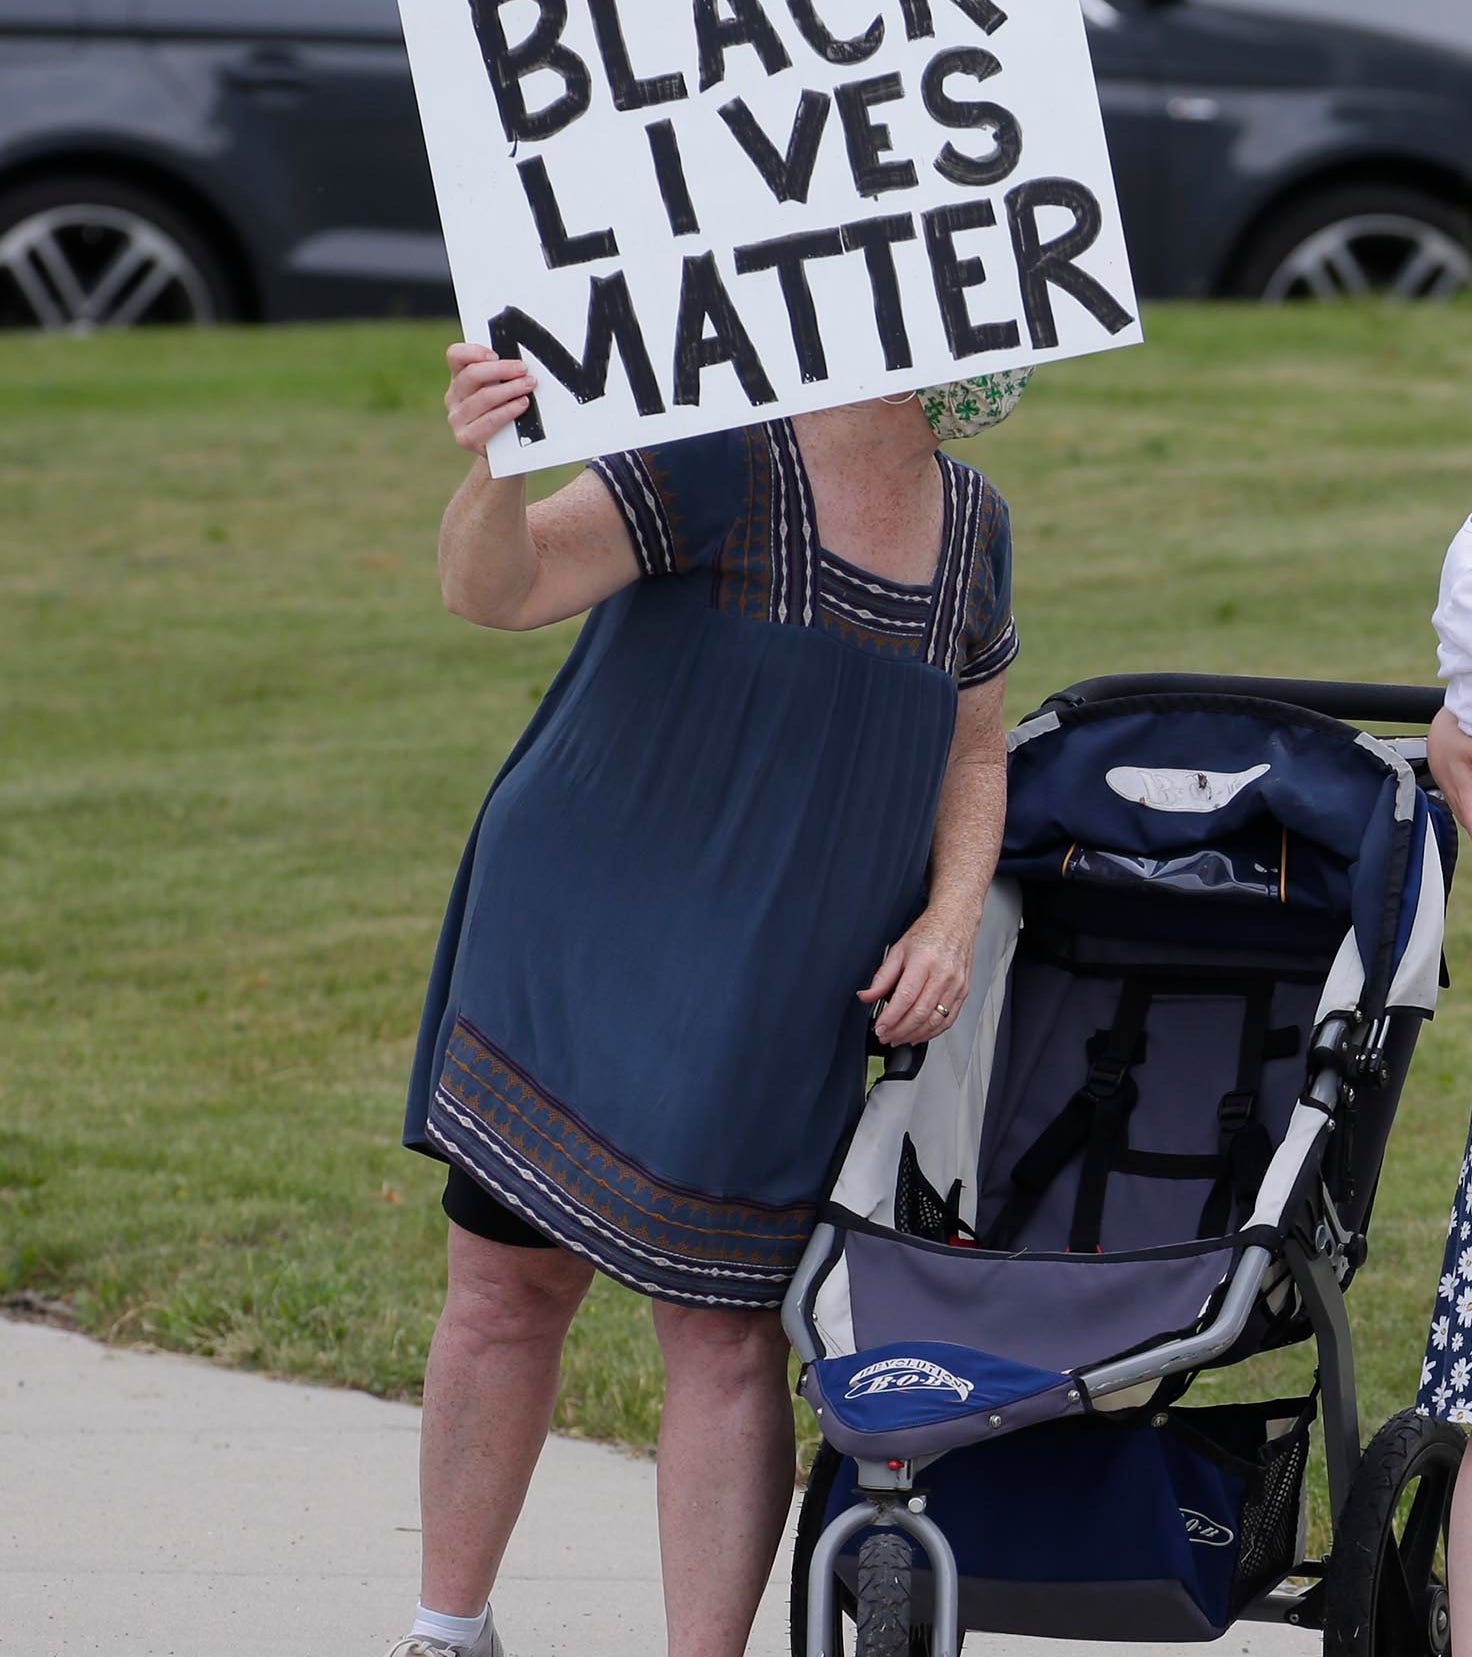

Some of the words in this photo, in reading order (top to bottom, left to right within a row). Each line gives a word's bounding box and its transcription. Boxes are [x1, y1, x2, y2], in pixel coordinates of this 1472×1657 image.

[515, 45, 1023, 270] LIVES
[487, 176, 1134, 447] MATTER
[858, 1358, 964, 1389] REVOLUTION
